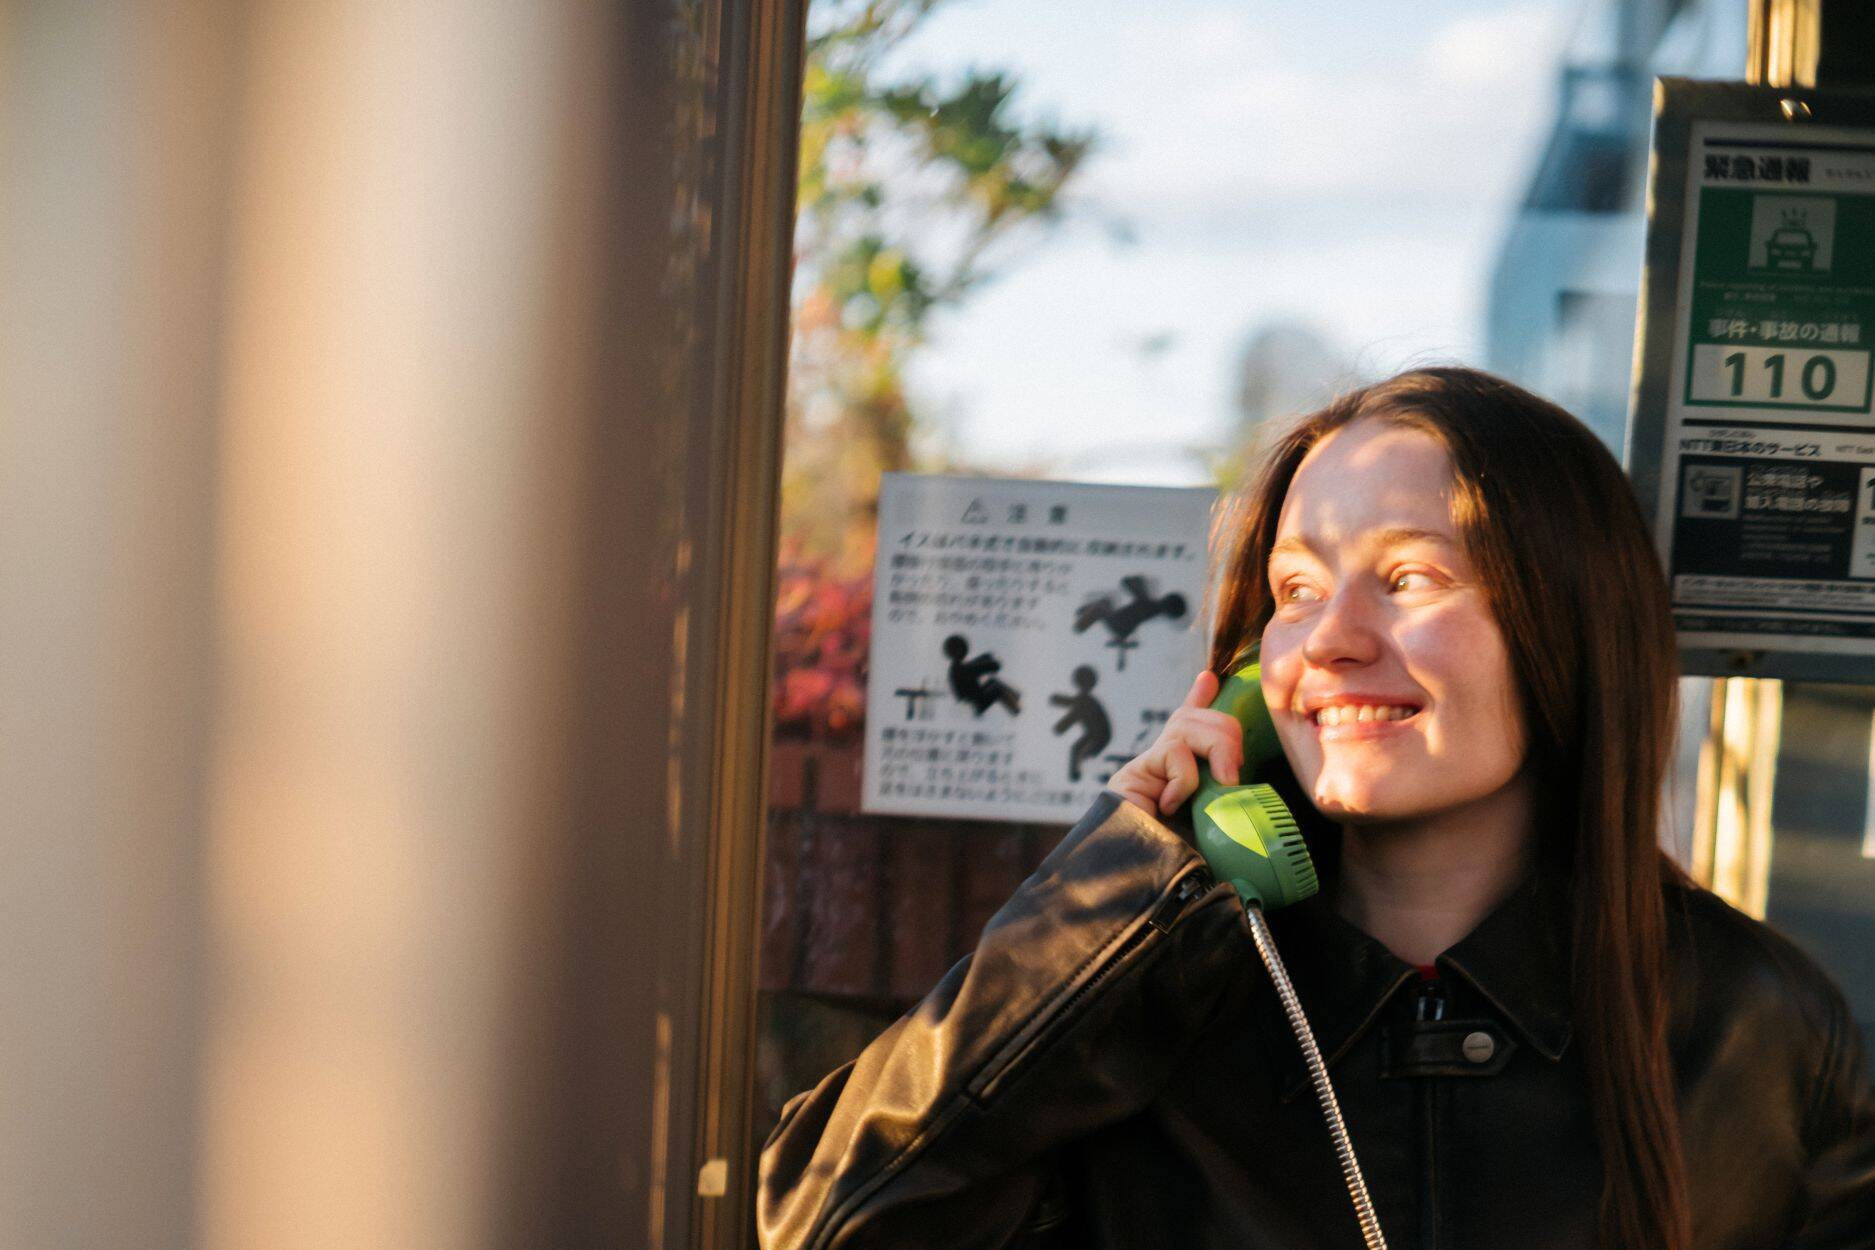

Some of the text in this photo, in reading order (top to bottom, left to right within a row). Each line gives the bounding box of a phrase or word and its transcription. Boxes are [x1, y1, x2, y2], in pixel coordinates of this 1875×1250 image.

[1703, 153, 1811, 183] 緊急通報
[1724, 352, 1837, 401] 110
